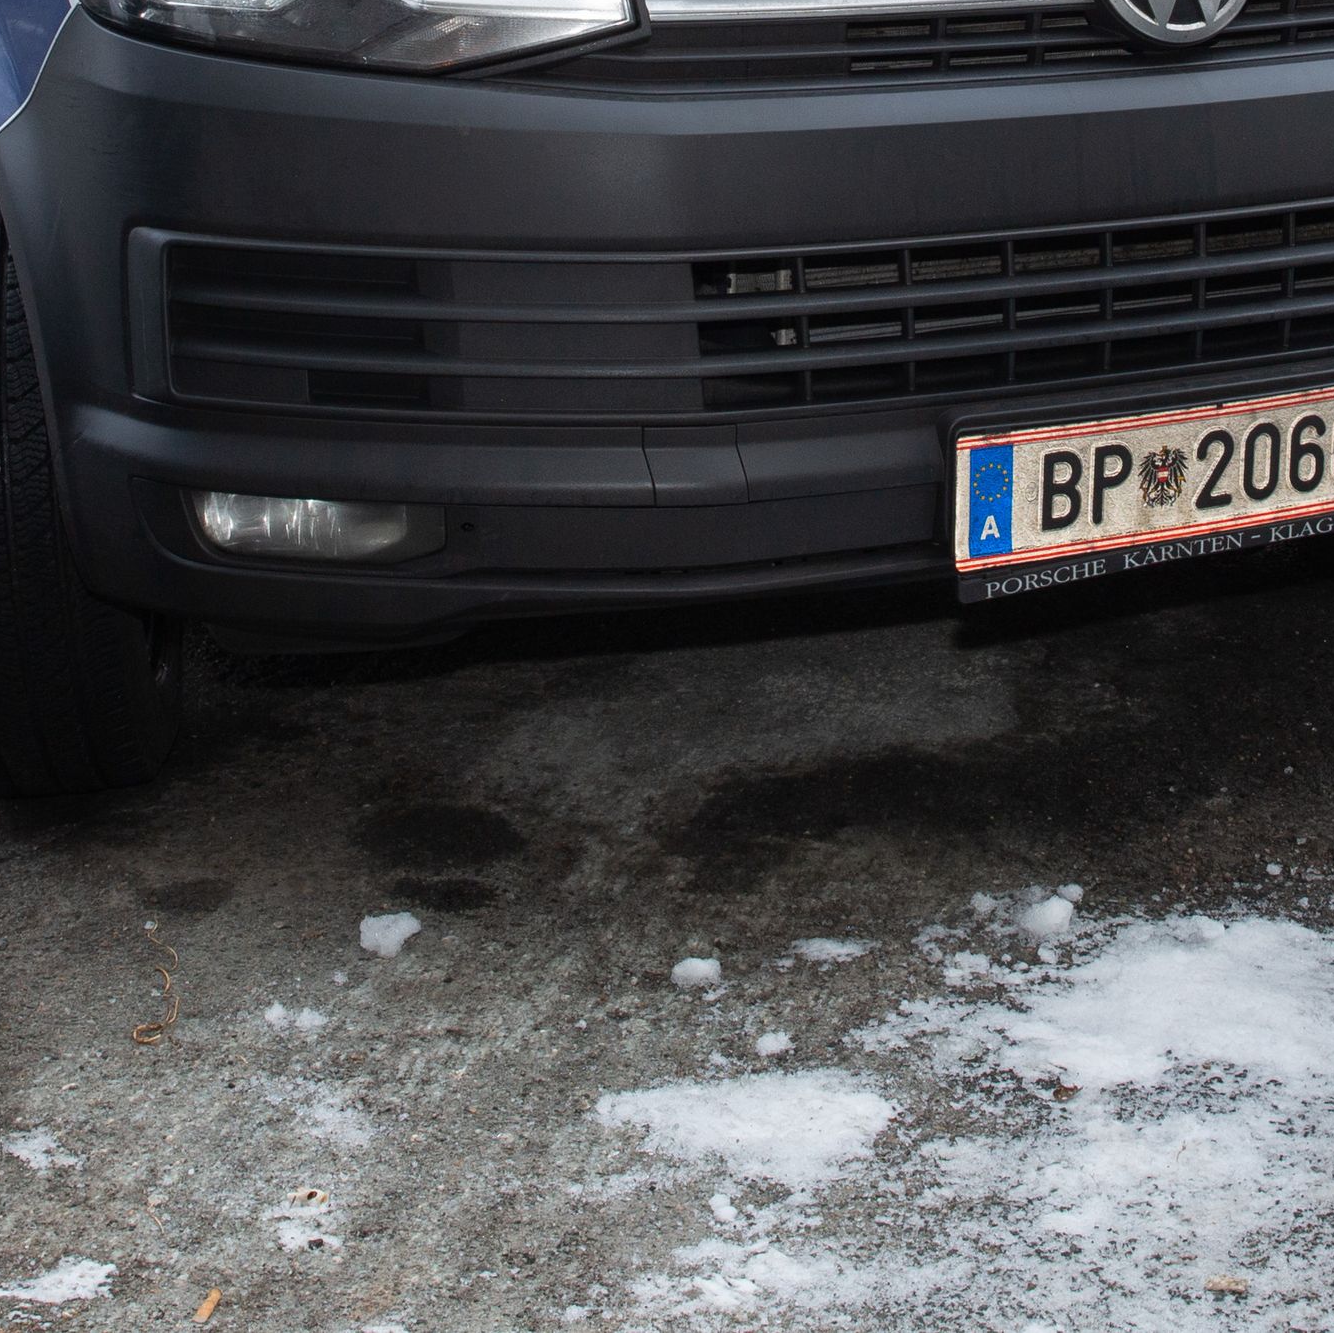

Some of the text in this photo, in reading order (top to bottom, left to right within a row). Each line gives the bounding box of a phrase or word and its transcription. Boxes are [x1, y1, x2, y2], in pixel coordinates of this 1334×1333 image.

[1040, 443, 1134, 531] BP
[980, 515, 1001, 541] A
[985, 558, 1107, 599] PORSCHE
[1123, 532, 1244, 570] KÄRNTEN
